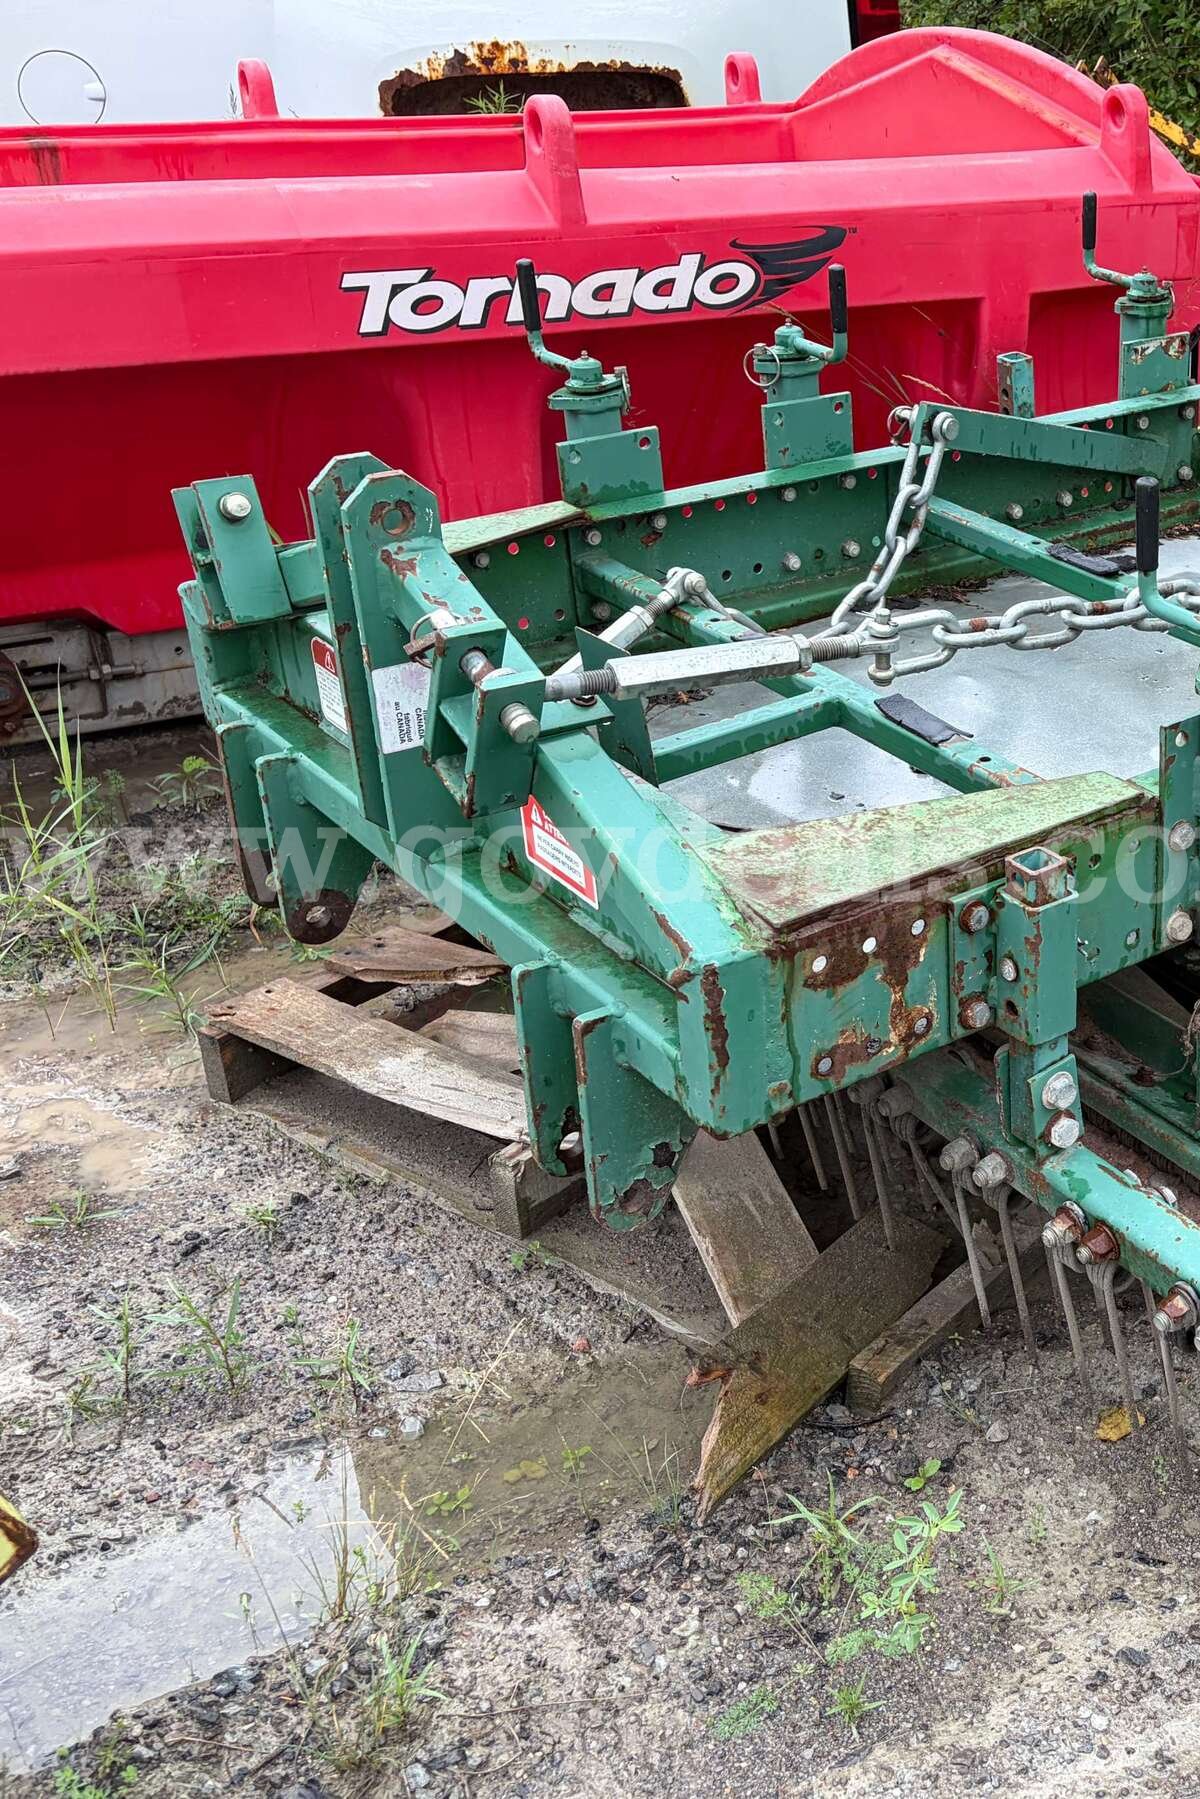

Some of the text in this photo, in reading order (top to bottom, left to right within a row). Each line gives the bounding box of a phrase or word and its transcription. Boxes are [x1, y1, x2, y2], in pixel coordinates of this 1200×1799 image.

[341, 250, 764, 337] Tornado
[396, 712, 406, 745] CANADA
[415, 708, 425, 740] CANADA
